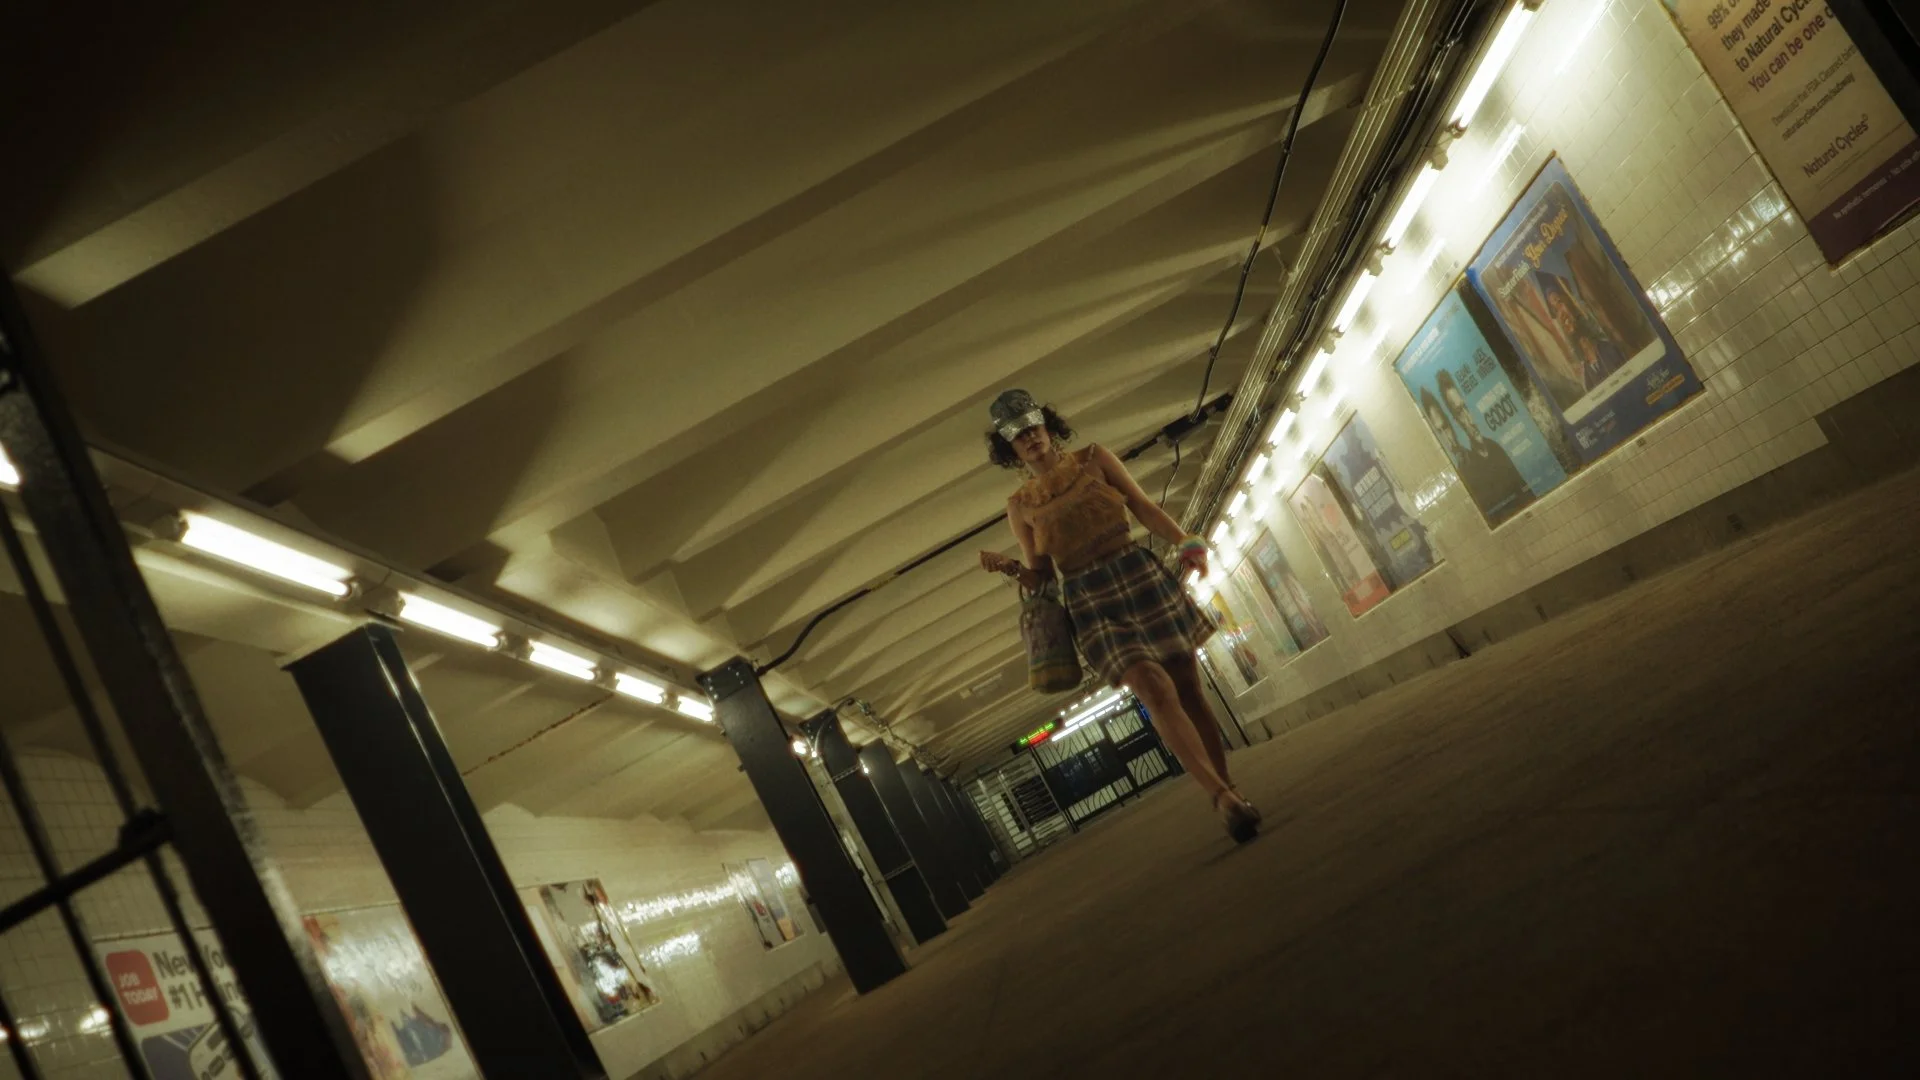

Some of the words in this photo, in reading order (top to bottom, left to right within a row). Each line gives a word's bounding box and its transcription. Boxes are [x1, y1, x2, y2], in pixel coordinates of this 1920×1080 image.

[1707, 4, 1730, 30] 99%
[1720, 25, 1746, 51] they
[1742, 0, 1771, 30] made
[1735, 57, 1750, 72] to
[1746, 16, 1784, 62] Natural
[1748, 71, 1773, 92] You
[1768, 52, 1790, 75] can
[1785, 37, 1804, 57] be
[1802, 14, 1826, 41] one
[1803, 142, 1839, 178] Natural
[1484, 393, 1518, 432] GODOT
[119, 973, 140, 988] JOB
[123, 987, 158, 1005] TODAY
[168, 983, 193, 1010] #1
